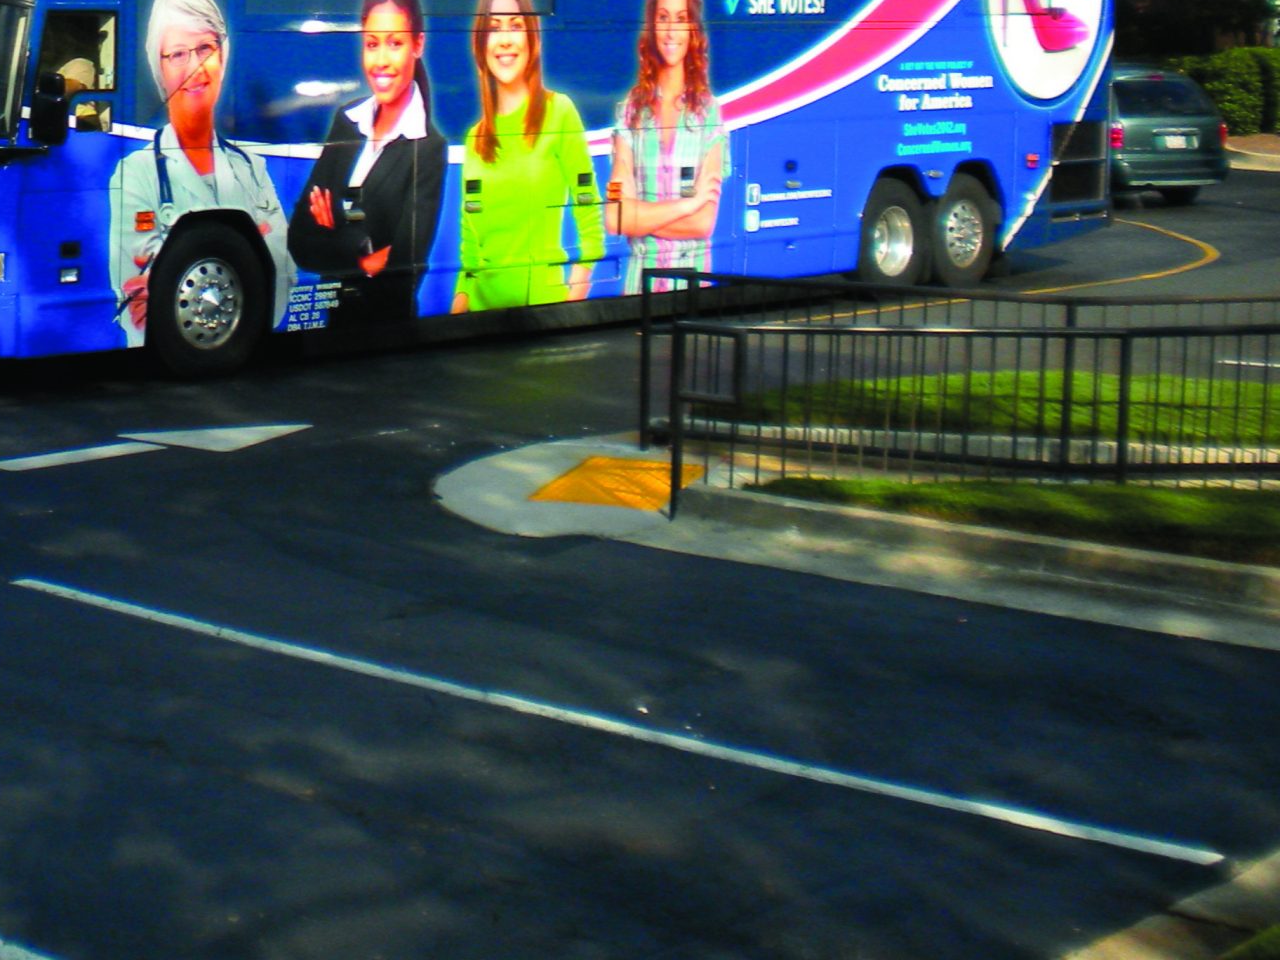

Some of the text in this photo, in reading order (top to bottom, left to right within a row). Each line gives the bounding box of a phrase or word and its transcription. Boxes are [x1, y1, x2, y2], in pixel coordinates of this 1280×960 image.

[878, 72, 994, 92] Concerned Women
[898, 92, 973, 111] for America
